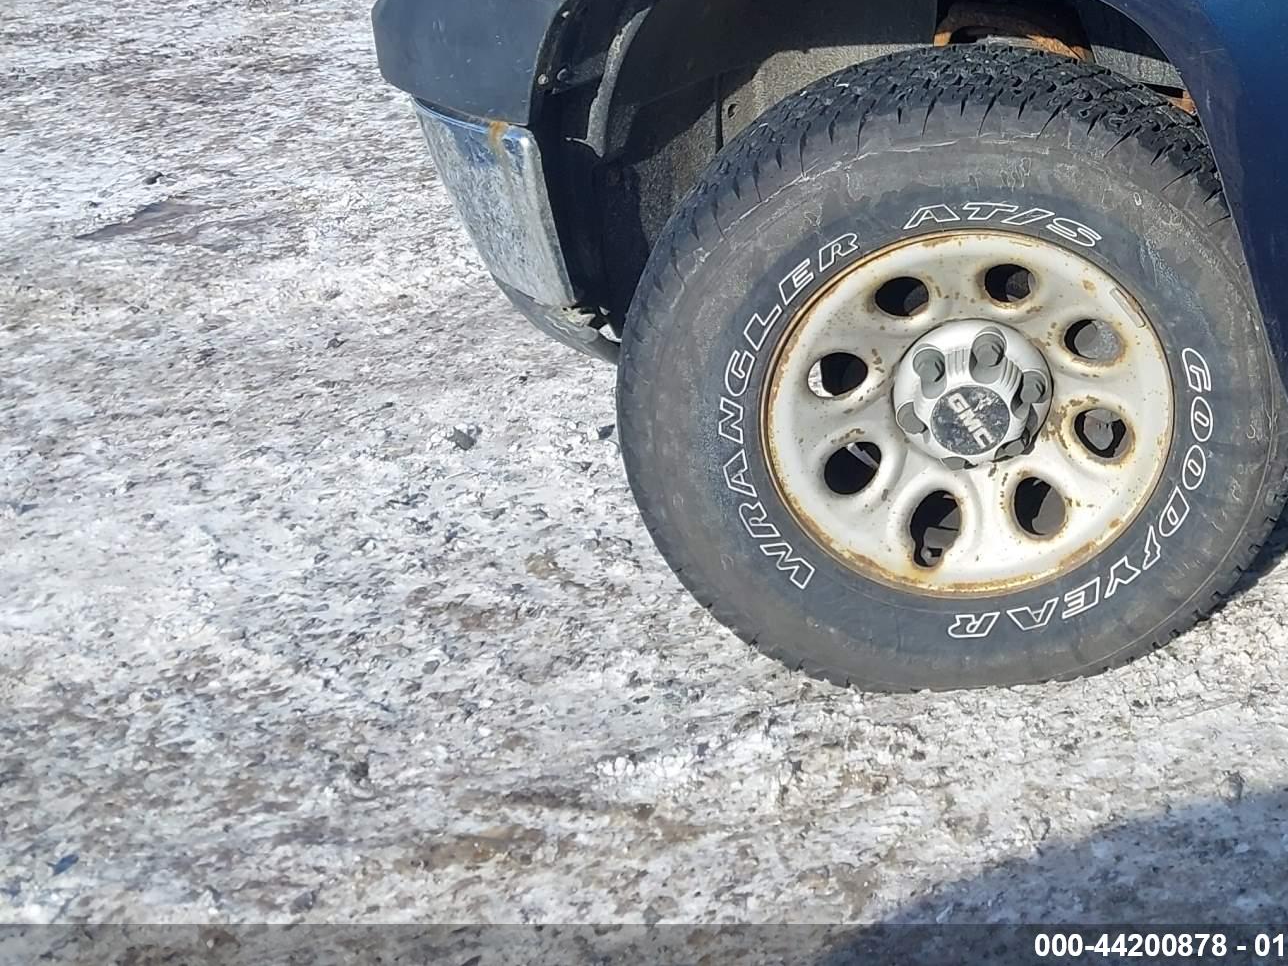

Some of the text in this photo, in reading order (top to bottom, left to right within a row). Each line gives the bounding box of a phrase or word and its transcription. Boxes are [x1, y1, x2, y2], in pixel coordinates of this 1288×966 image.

[718, 233, 860, 590] WRANGLER
[947, 347, 1214, 639] GOODYEAR
[948, 392, 997, 449] GMC
